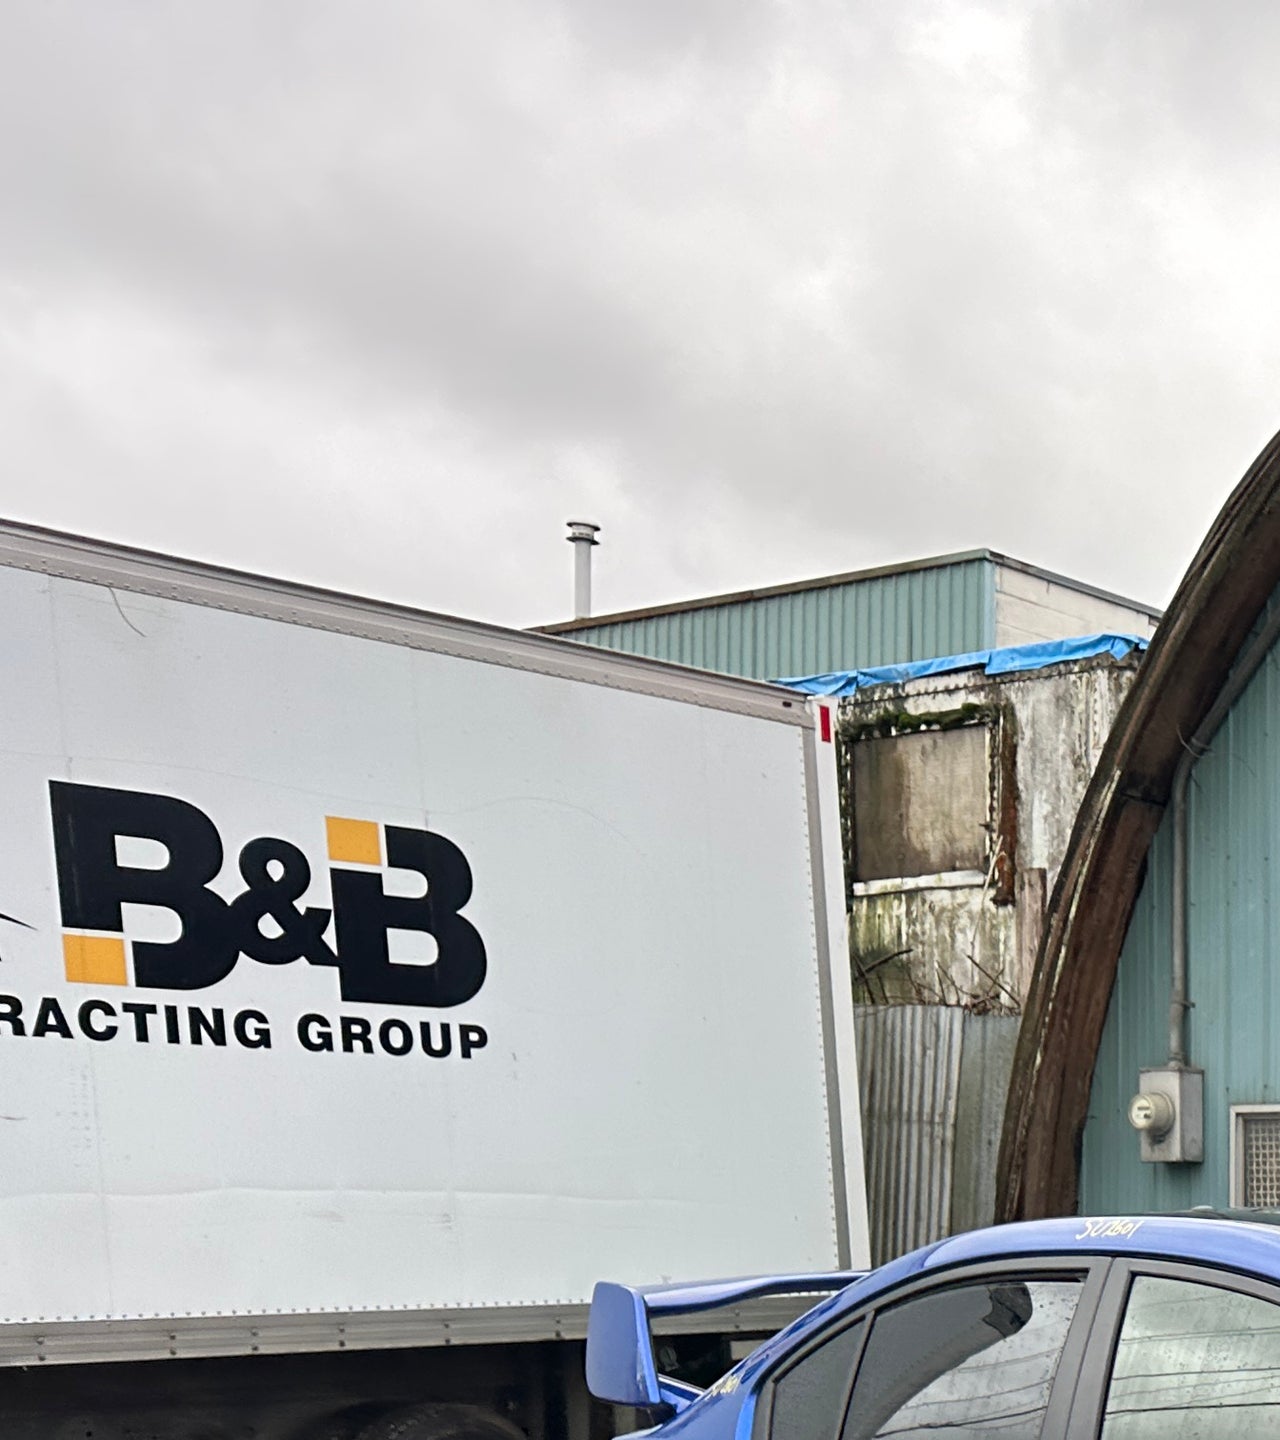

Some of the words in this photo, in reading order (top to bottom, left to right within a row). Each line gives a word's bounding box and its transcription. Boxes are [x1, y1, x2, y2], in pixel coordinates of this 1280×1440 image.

[49, 780, 488, 1008] B&B
[0, 994, 272, 1049] RACTING
[297, 1013, 489, 1060] GROUP
